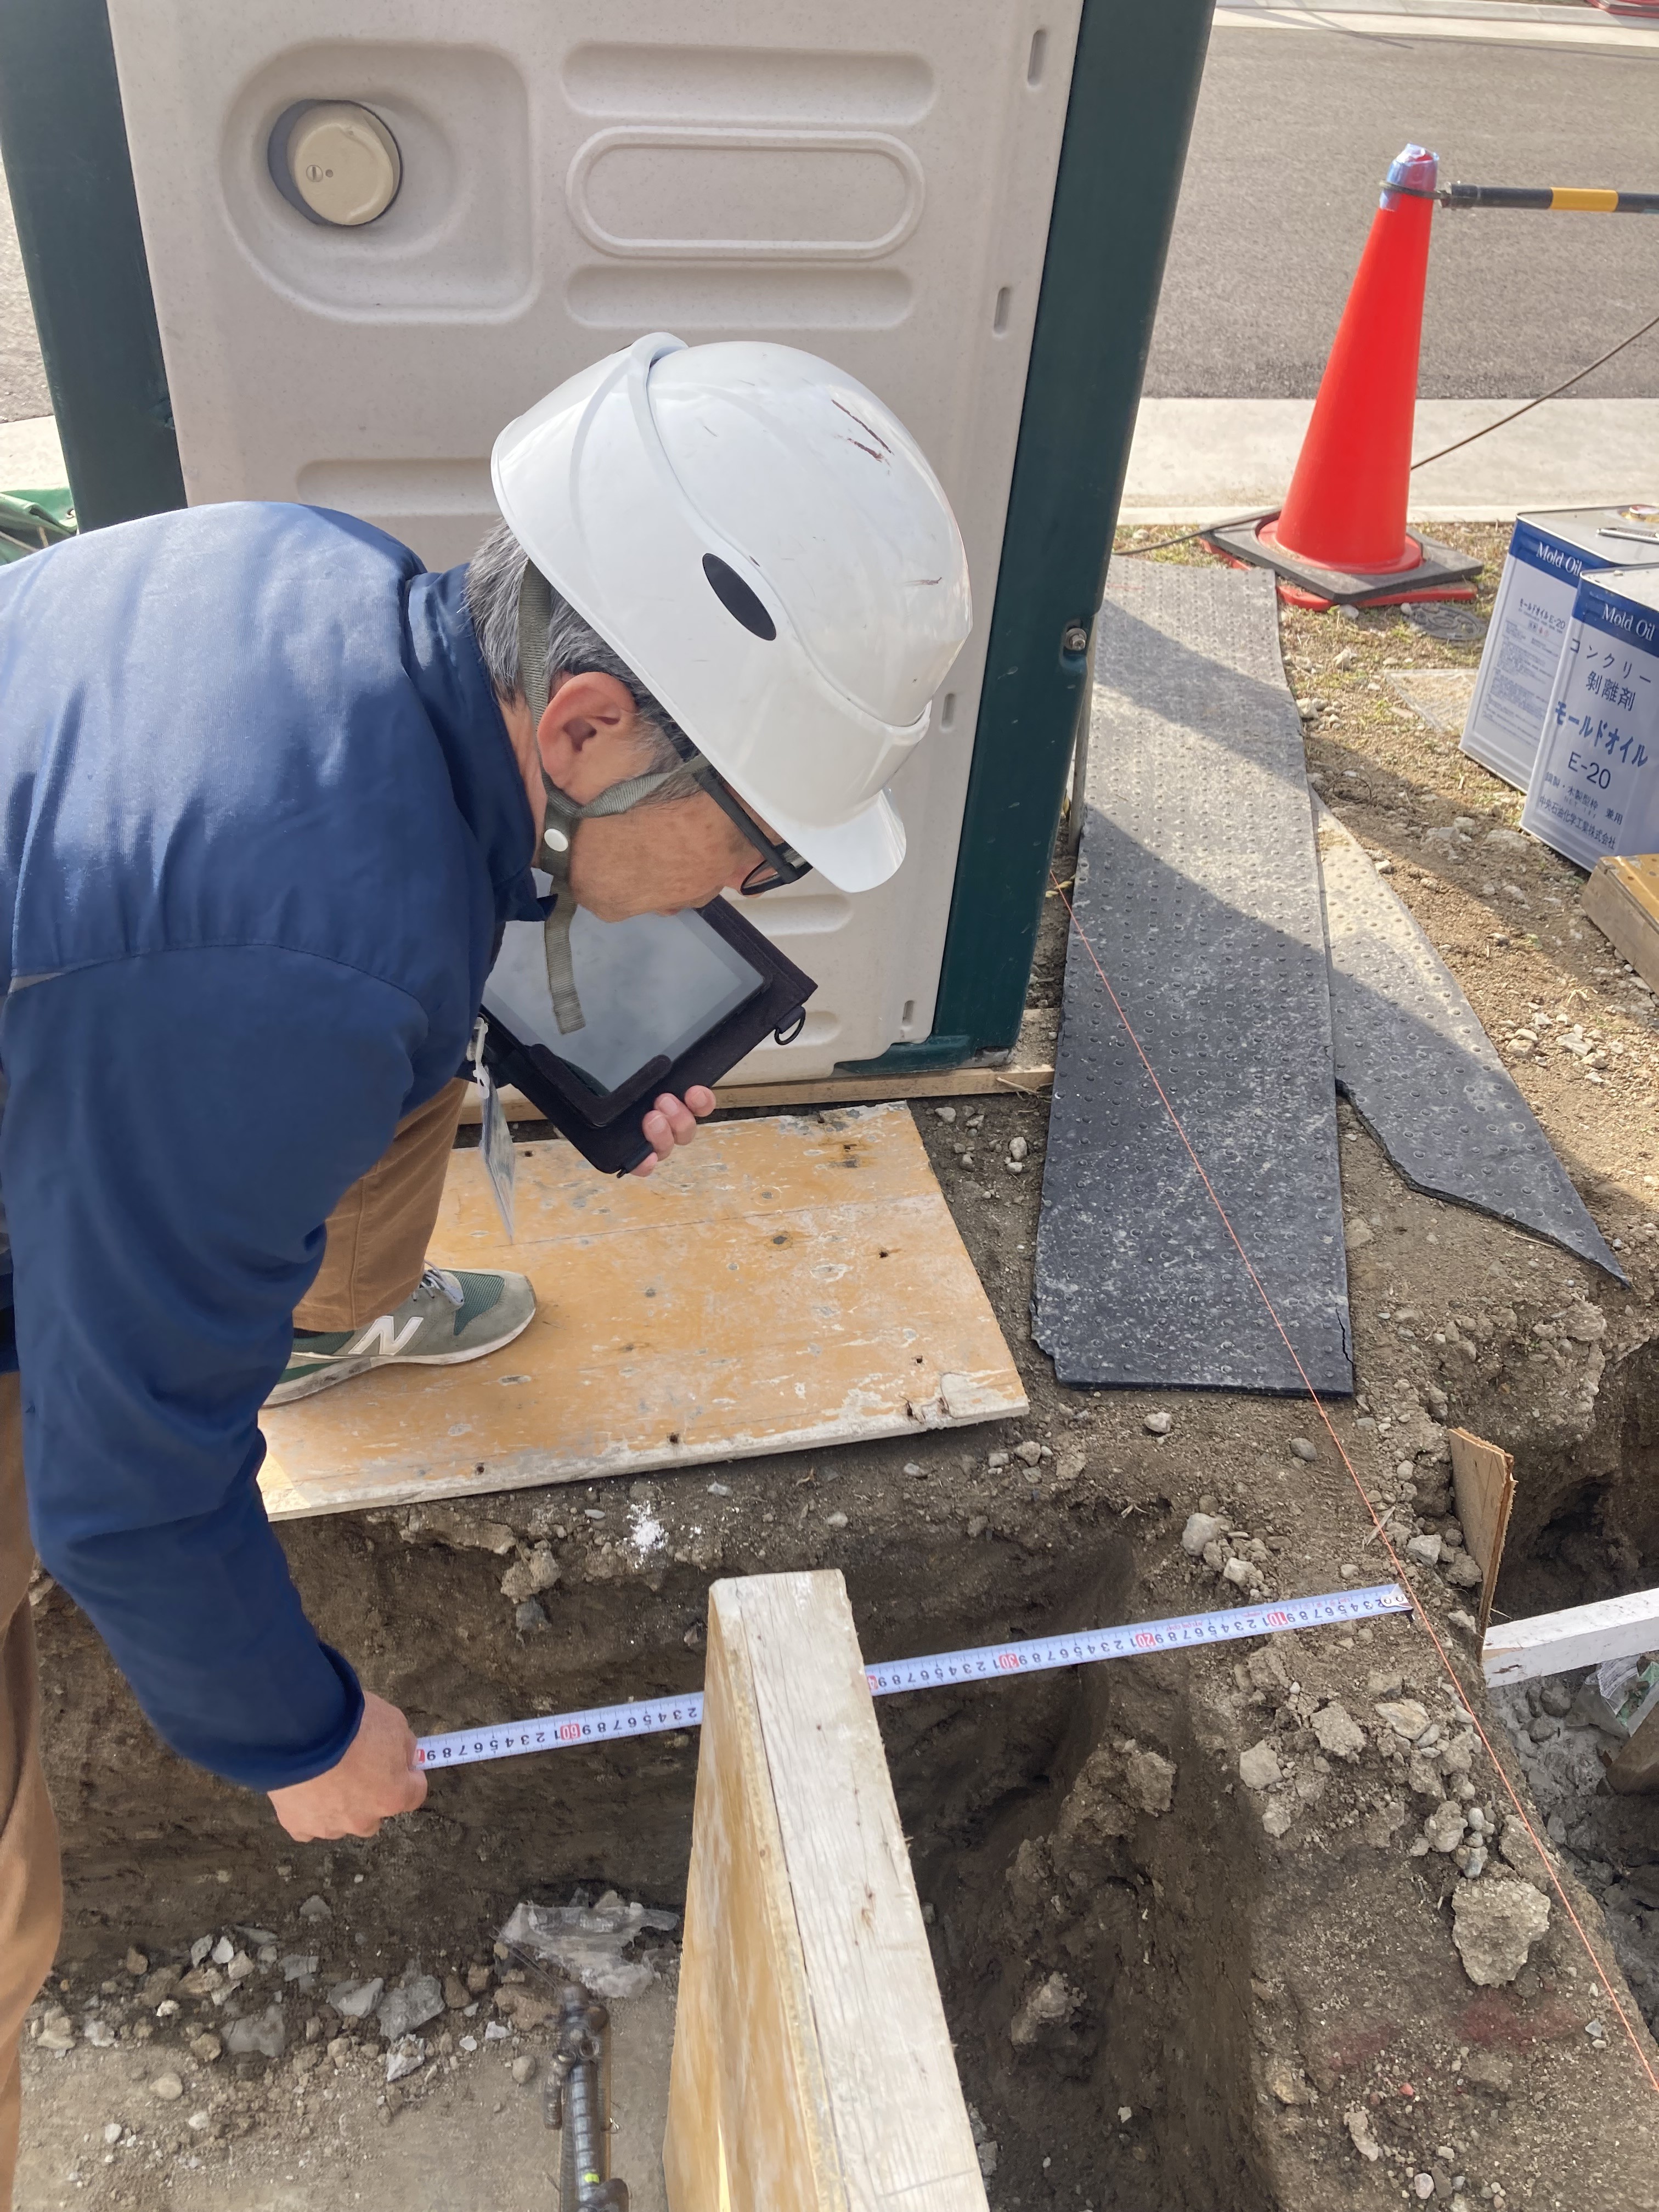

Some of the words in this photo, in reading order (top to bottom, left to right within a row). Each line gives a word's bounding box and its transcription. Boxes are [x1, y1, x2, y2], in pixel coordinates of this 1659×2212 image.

[1536, 541, 1564, 568] Mold
[1565, 556, 1582, 577] Oil
[1601, 603, 1630, 631] Mold
[1636, 619, 1655, 641] Oil
[1555, 701, 1648, 768] モールドオイル
[1568, 751, 1611, 789] E-20
[348, 1316, 424, 1356] N
[657, 1713, 667, 1723] 4
[673, 1709, 682, 1721] 3
[687, 1707, 697, 1718] 2
[613, 1719, 623, 1731] 7
[627, 1717, 637, 1728] 6
[642, 1714, 652, 1726] 5
[561, 1724, 580, 1740] 60
[582, 1724, 591, 1735] 9
[597, 1722, 607, 1733] 8
[520, 1734, 530, 1746] 3
[535, 1731, 545, 1743] 2
[554, 1730, 561, 1741] 1
[473, 1742, 483, 1753] 6
[489, 1740, 499, 1751] 5
[505, 1737, 515, 1748] 4
[426, 1750, 436, 1761] 9
[442, 1747, 452, 1759] 8
[458, 1745, 468, 1756] 7
